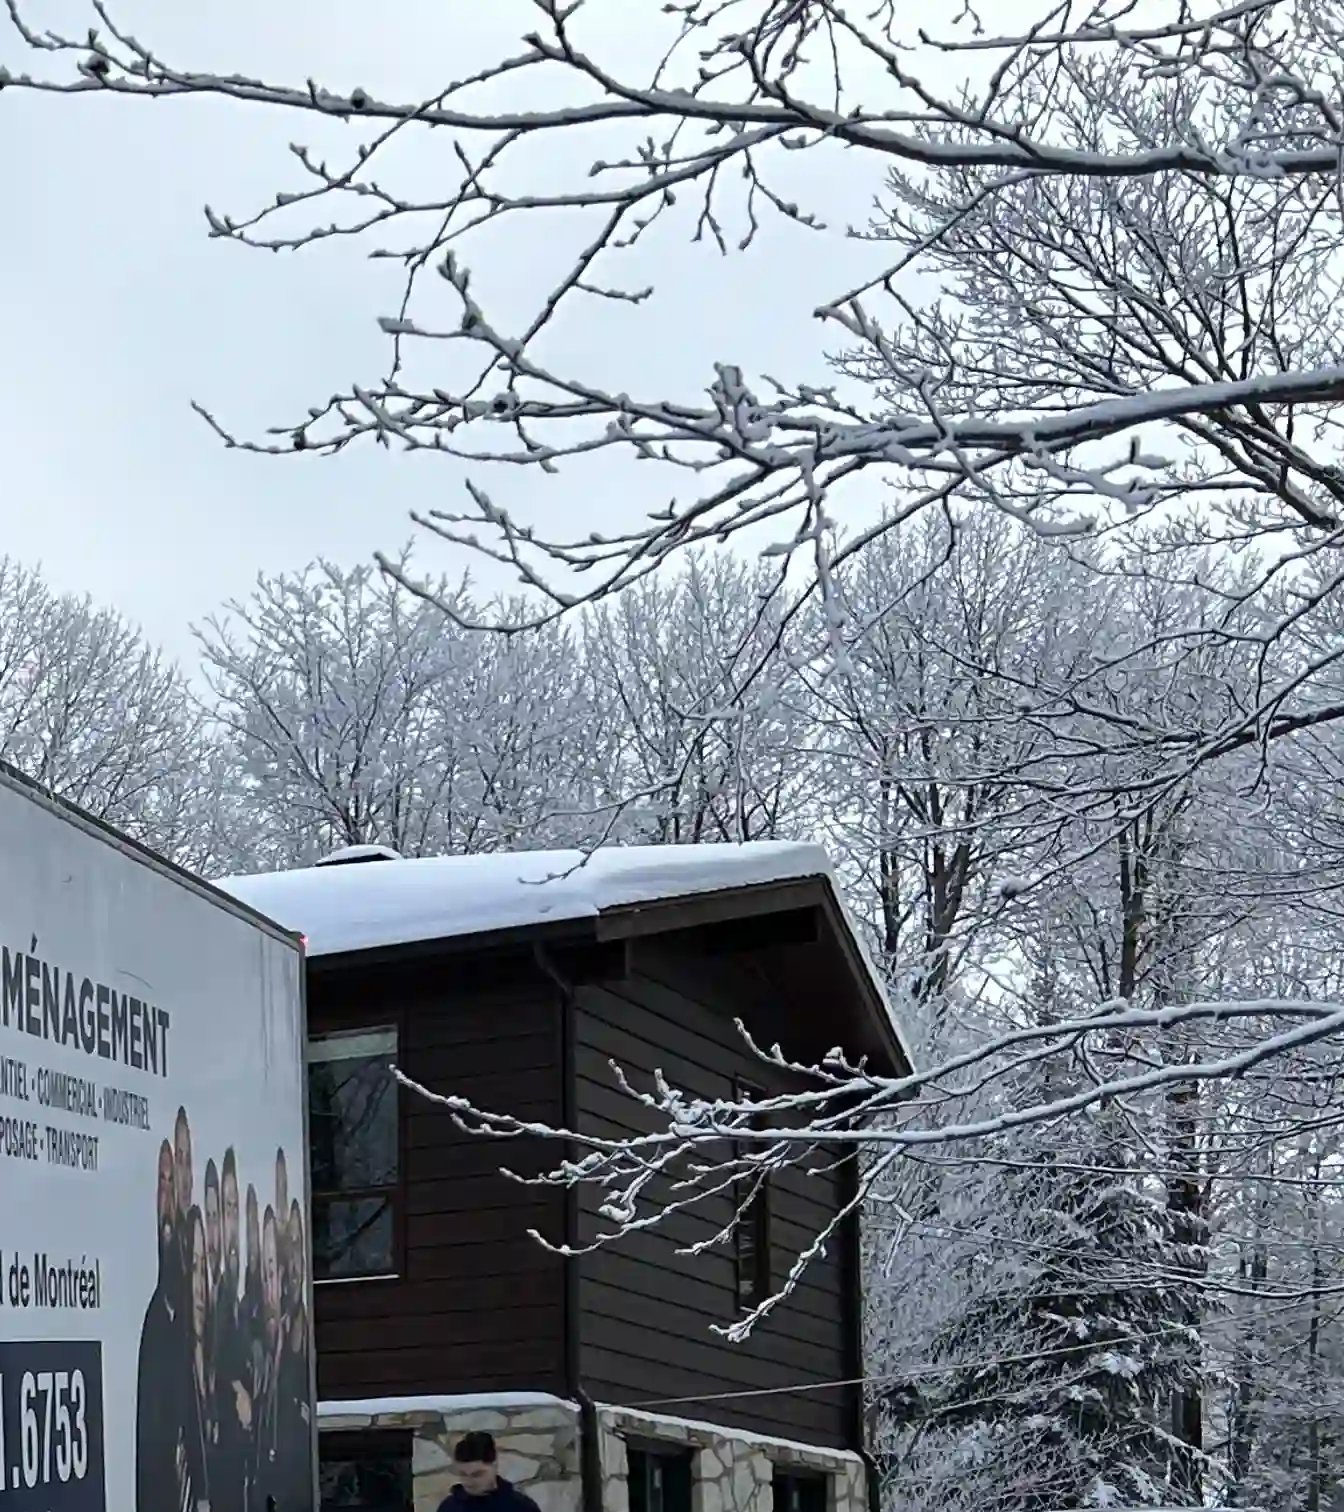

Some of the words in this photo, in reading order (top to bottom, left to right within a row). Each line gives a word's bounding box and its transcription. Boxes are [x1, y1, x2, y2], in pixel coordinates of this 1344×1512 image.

[37, 1067, 98, 1118] COMMERCIAL
[45, 1126, 99, 1171] TRANSPORT
[9, 1252, 30, 1307] de
[34, 1253, 101, 1309] Montréal
